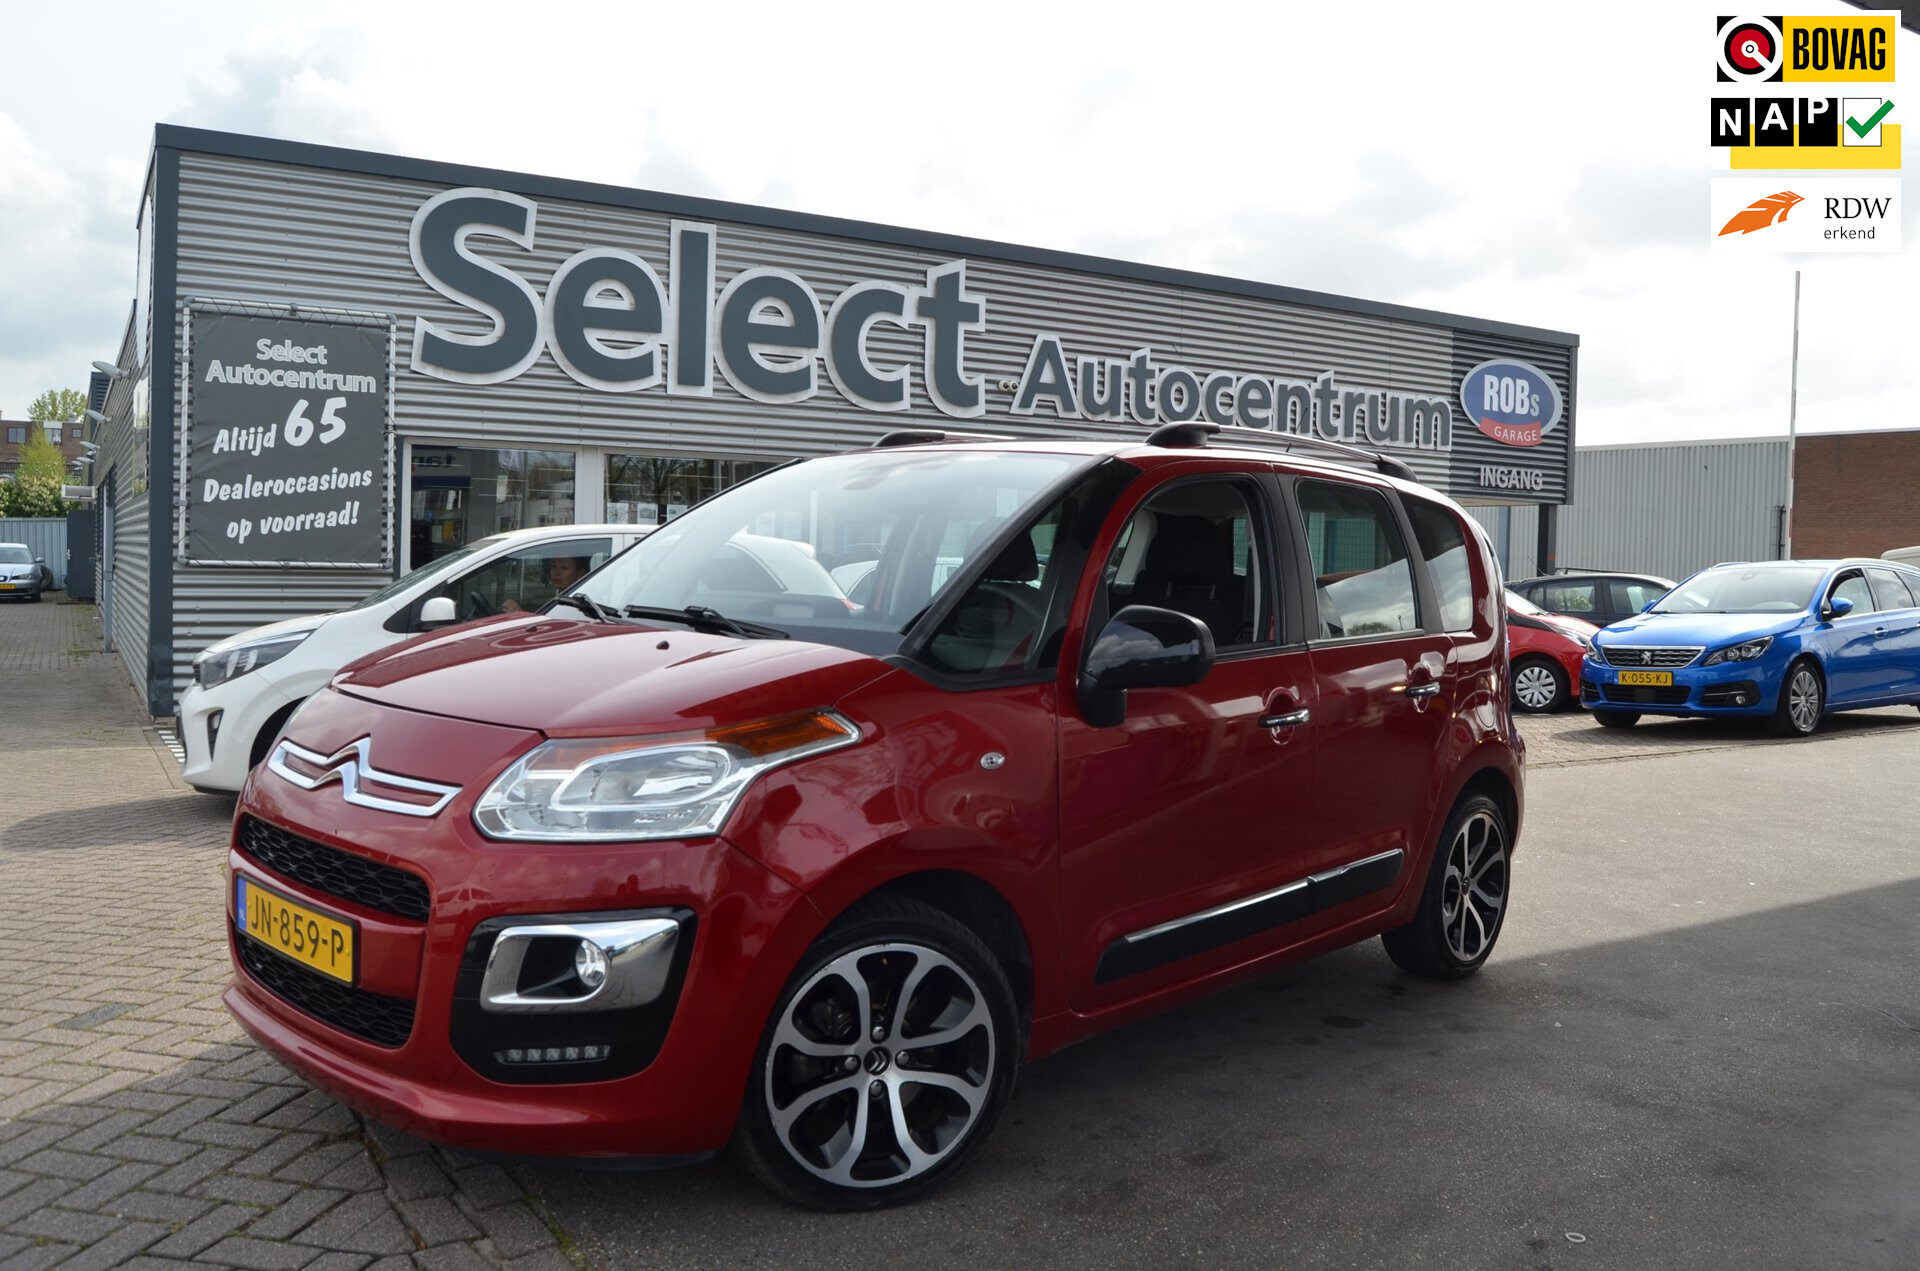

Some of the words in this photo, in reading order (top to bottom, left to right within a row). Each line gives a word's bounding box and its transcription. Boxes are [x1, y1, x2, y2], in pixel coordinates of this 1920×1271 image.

[409, 187, 986, 419] Select
[1010, 333, 1452, 452] Autocentrum
[256, 338, 328, 365] Select
[204, 359, 377, 393] Autocentrum
[1483, 374, 1540, 417] ROBs
[212, 423, 277, 456] Altijd
[284, 396, 347, 447] 65
[1494, 425, 1538, 442] GARAGE
[203, 467, 373, 503] Dealeroccasions
[1479, 464, 1544, 491] INGANG
[226, 519, 252, 544] op
[260, 500, 360, 535] voorraad!
[1621, 673, 1668, 684] K-055-KJ
[251, 894, 345, 968] JN-859-P
